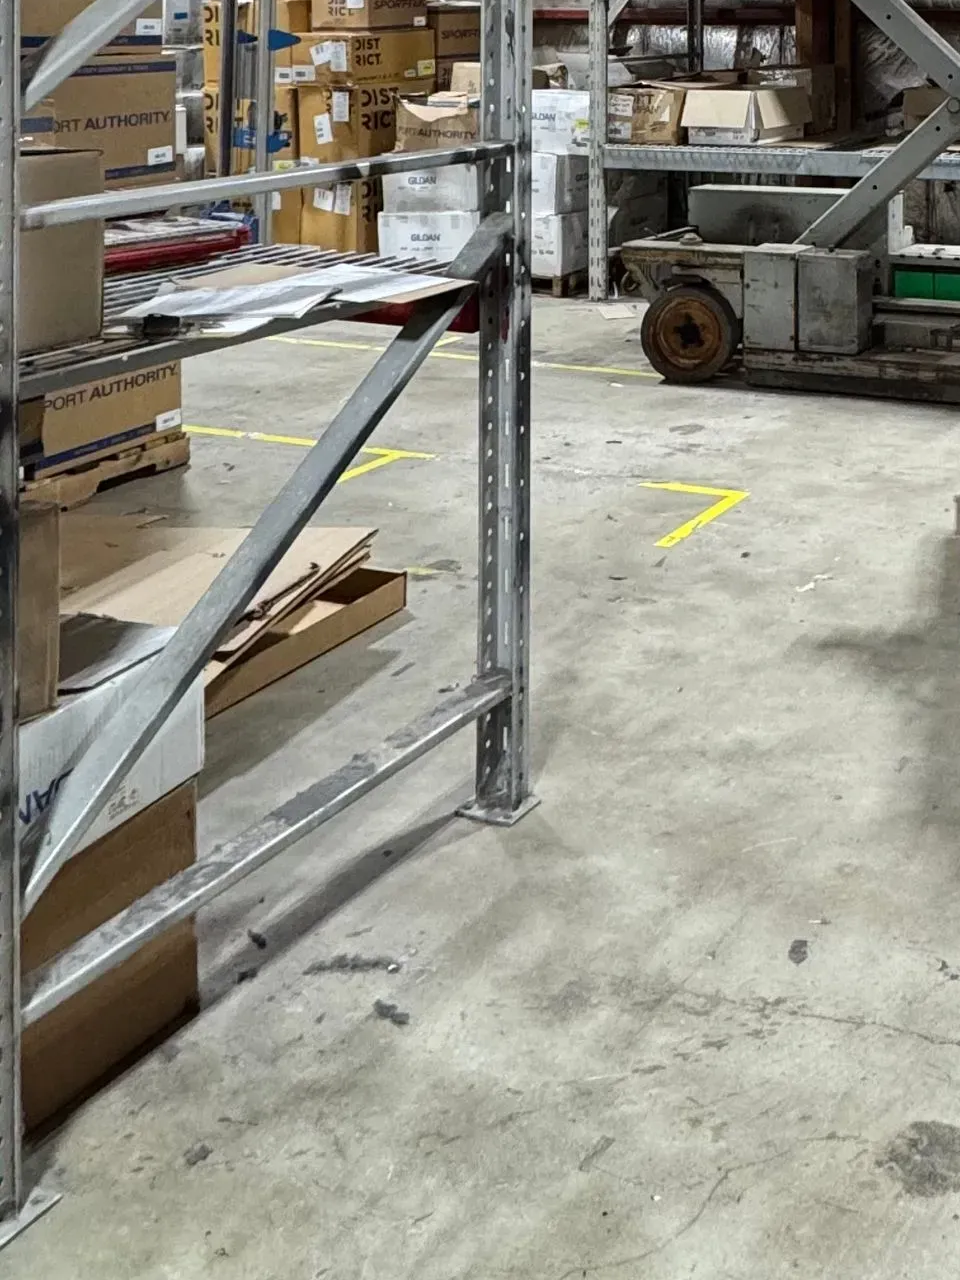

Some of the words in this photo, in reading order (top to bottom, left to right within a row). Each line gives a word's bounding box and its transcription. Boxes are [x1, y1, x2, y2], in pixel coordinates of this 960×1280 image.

[54, 120, 83, 134] ORT
[85, 111, 170, 131] AUTHORITY
[361, 111, 396, 130] RIC
[408, 176, 437, 185] GILDAN
[411, 234, 440, 242] GILDAN
[43, 391, 87, 411] PORT
[89, 364, 177, 402] AUTHORITY
